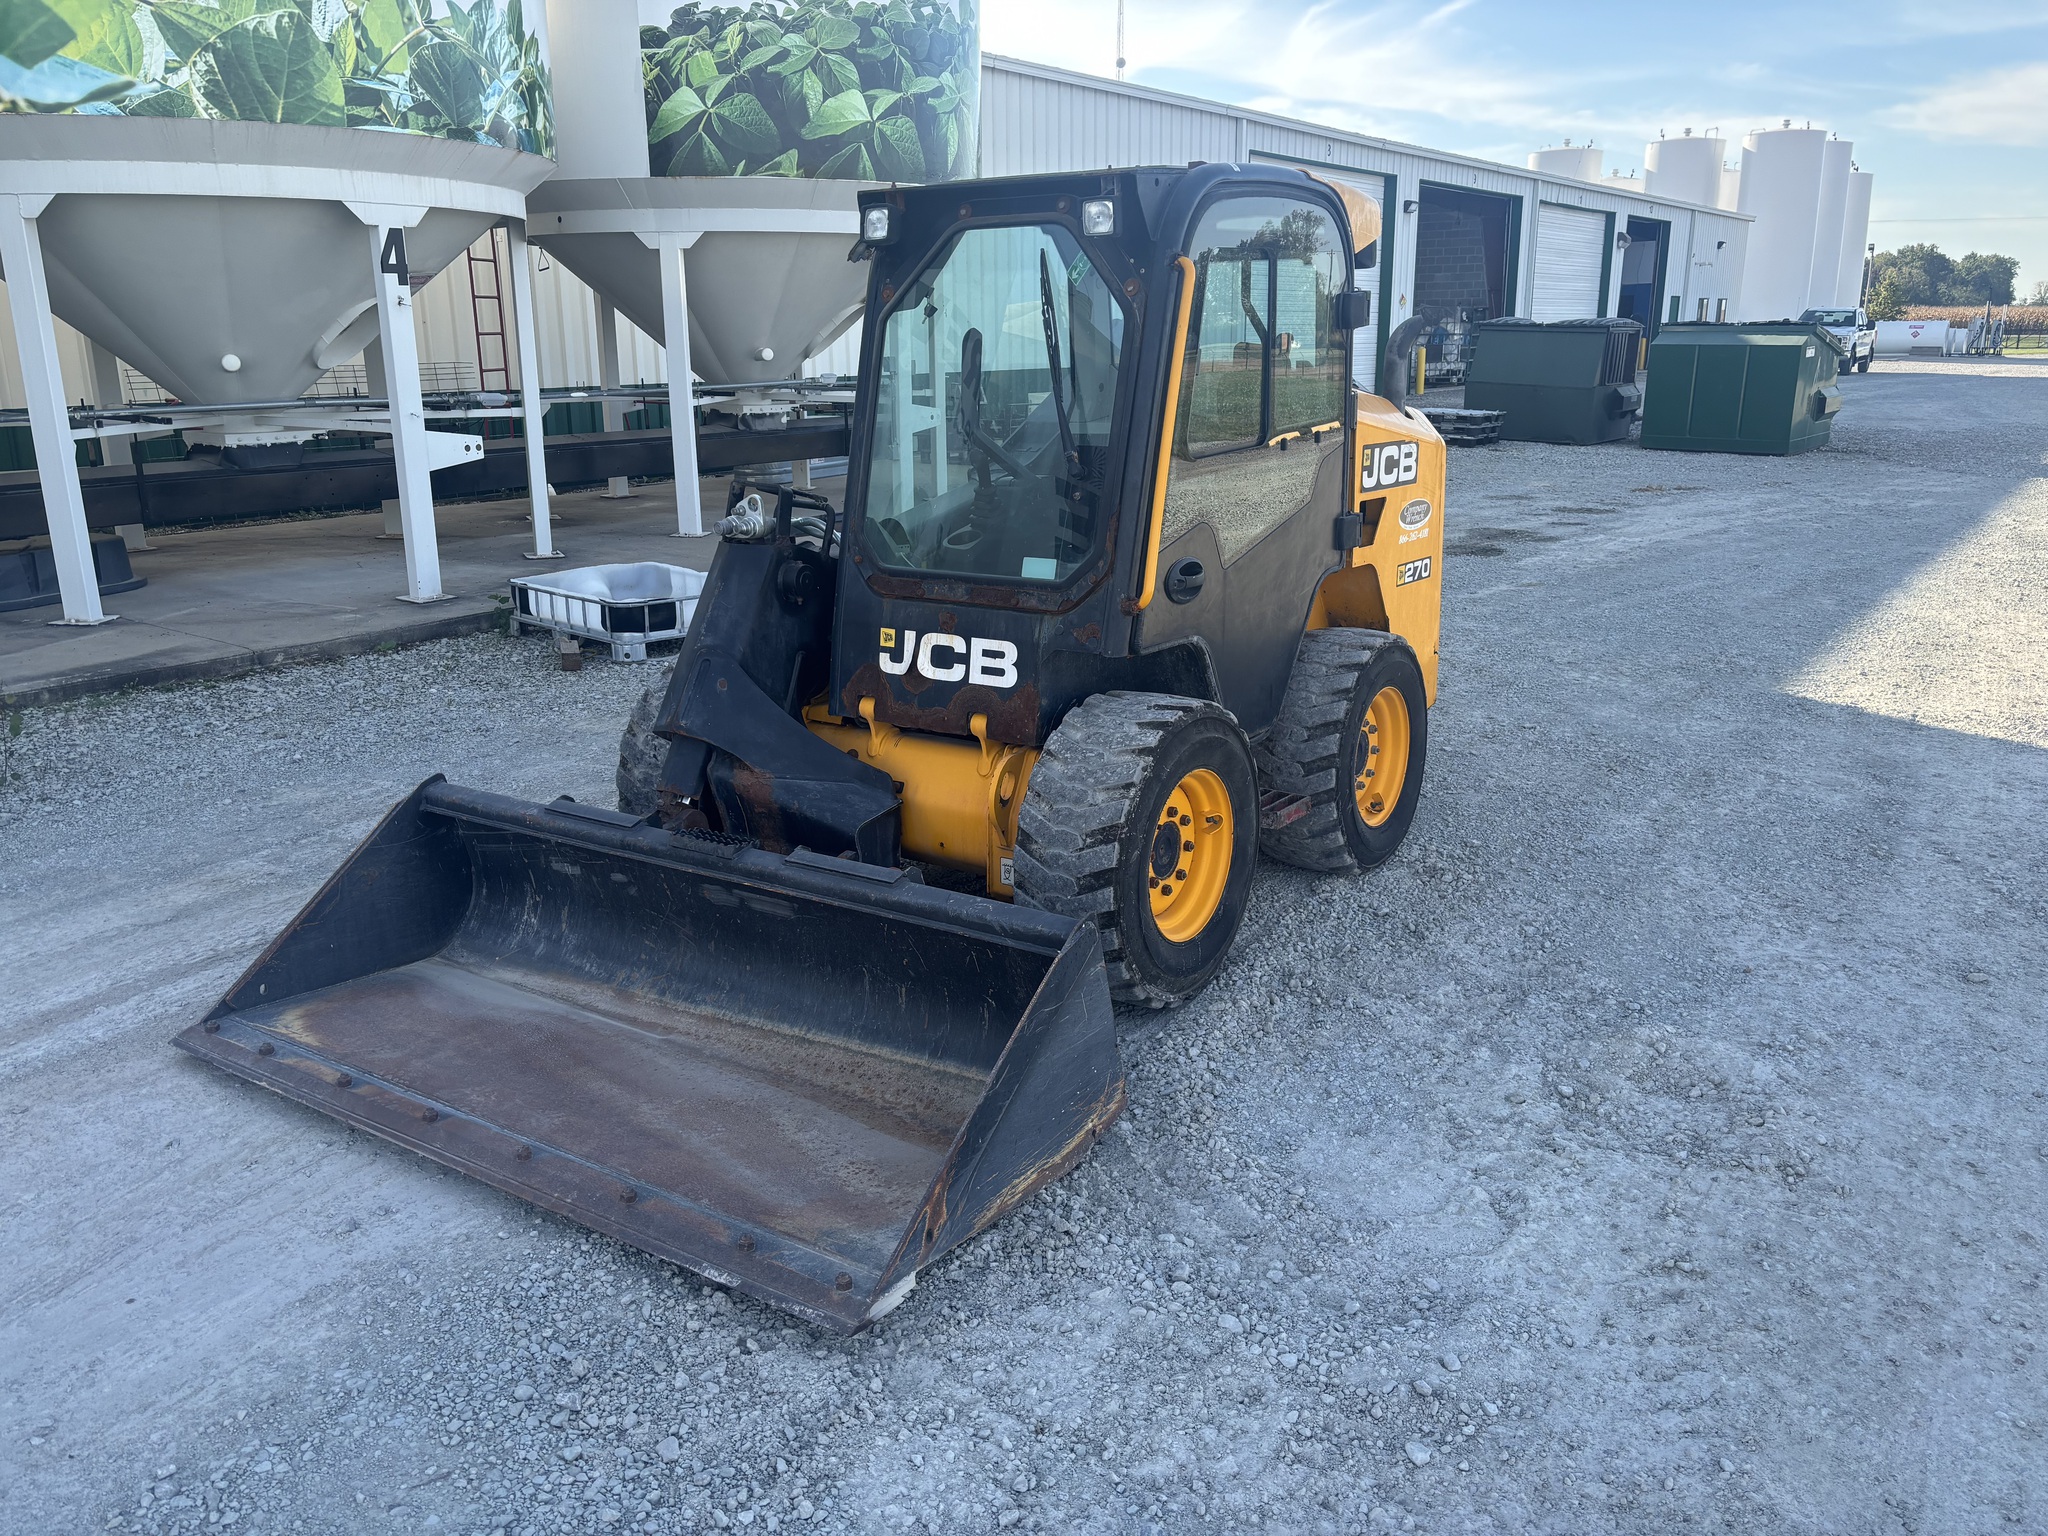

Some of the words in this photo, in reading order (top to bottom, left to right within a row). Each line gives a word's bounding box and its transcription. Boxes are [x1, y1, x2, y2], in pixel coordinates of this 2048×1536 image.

[380, 227, 409, 286] 4
[1362, 443, 1418, 489] JCB
[1405, 558, 1430, 583] 270
[879, 630, 1018, 688] JCB
